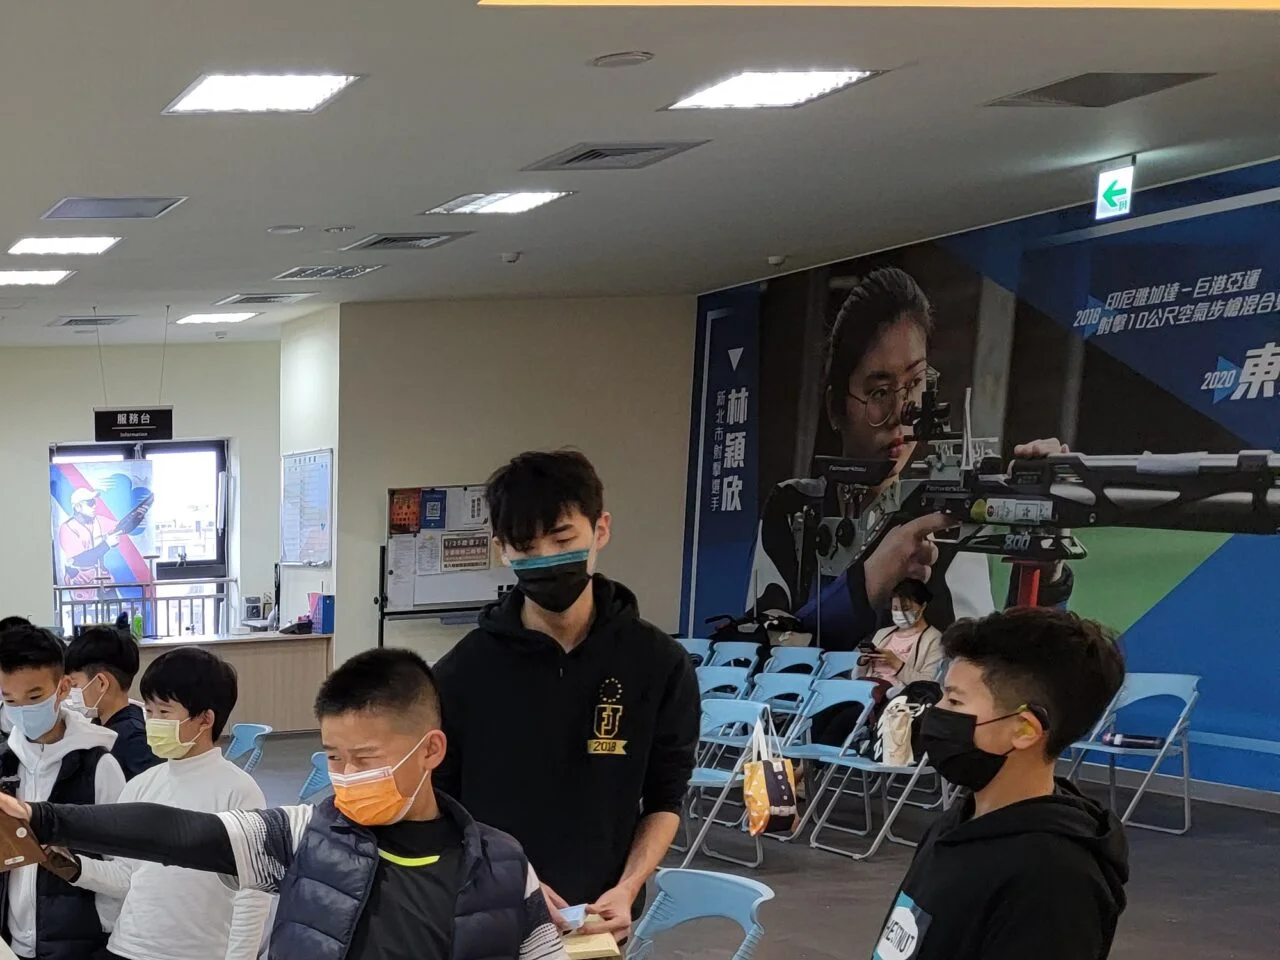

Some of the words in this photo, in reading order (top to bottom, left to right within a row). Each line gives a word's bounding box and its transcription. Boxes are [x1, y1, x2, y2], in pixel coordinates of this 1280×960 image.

[1073, 307, 1102, 328] 2018
[1200, 369, 1237, 390] 2020
[116, 412, 151, 425] 服務台
[1003, 533, 1031, 550] 800
[884, 919, 915, 955] HESTNUT
